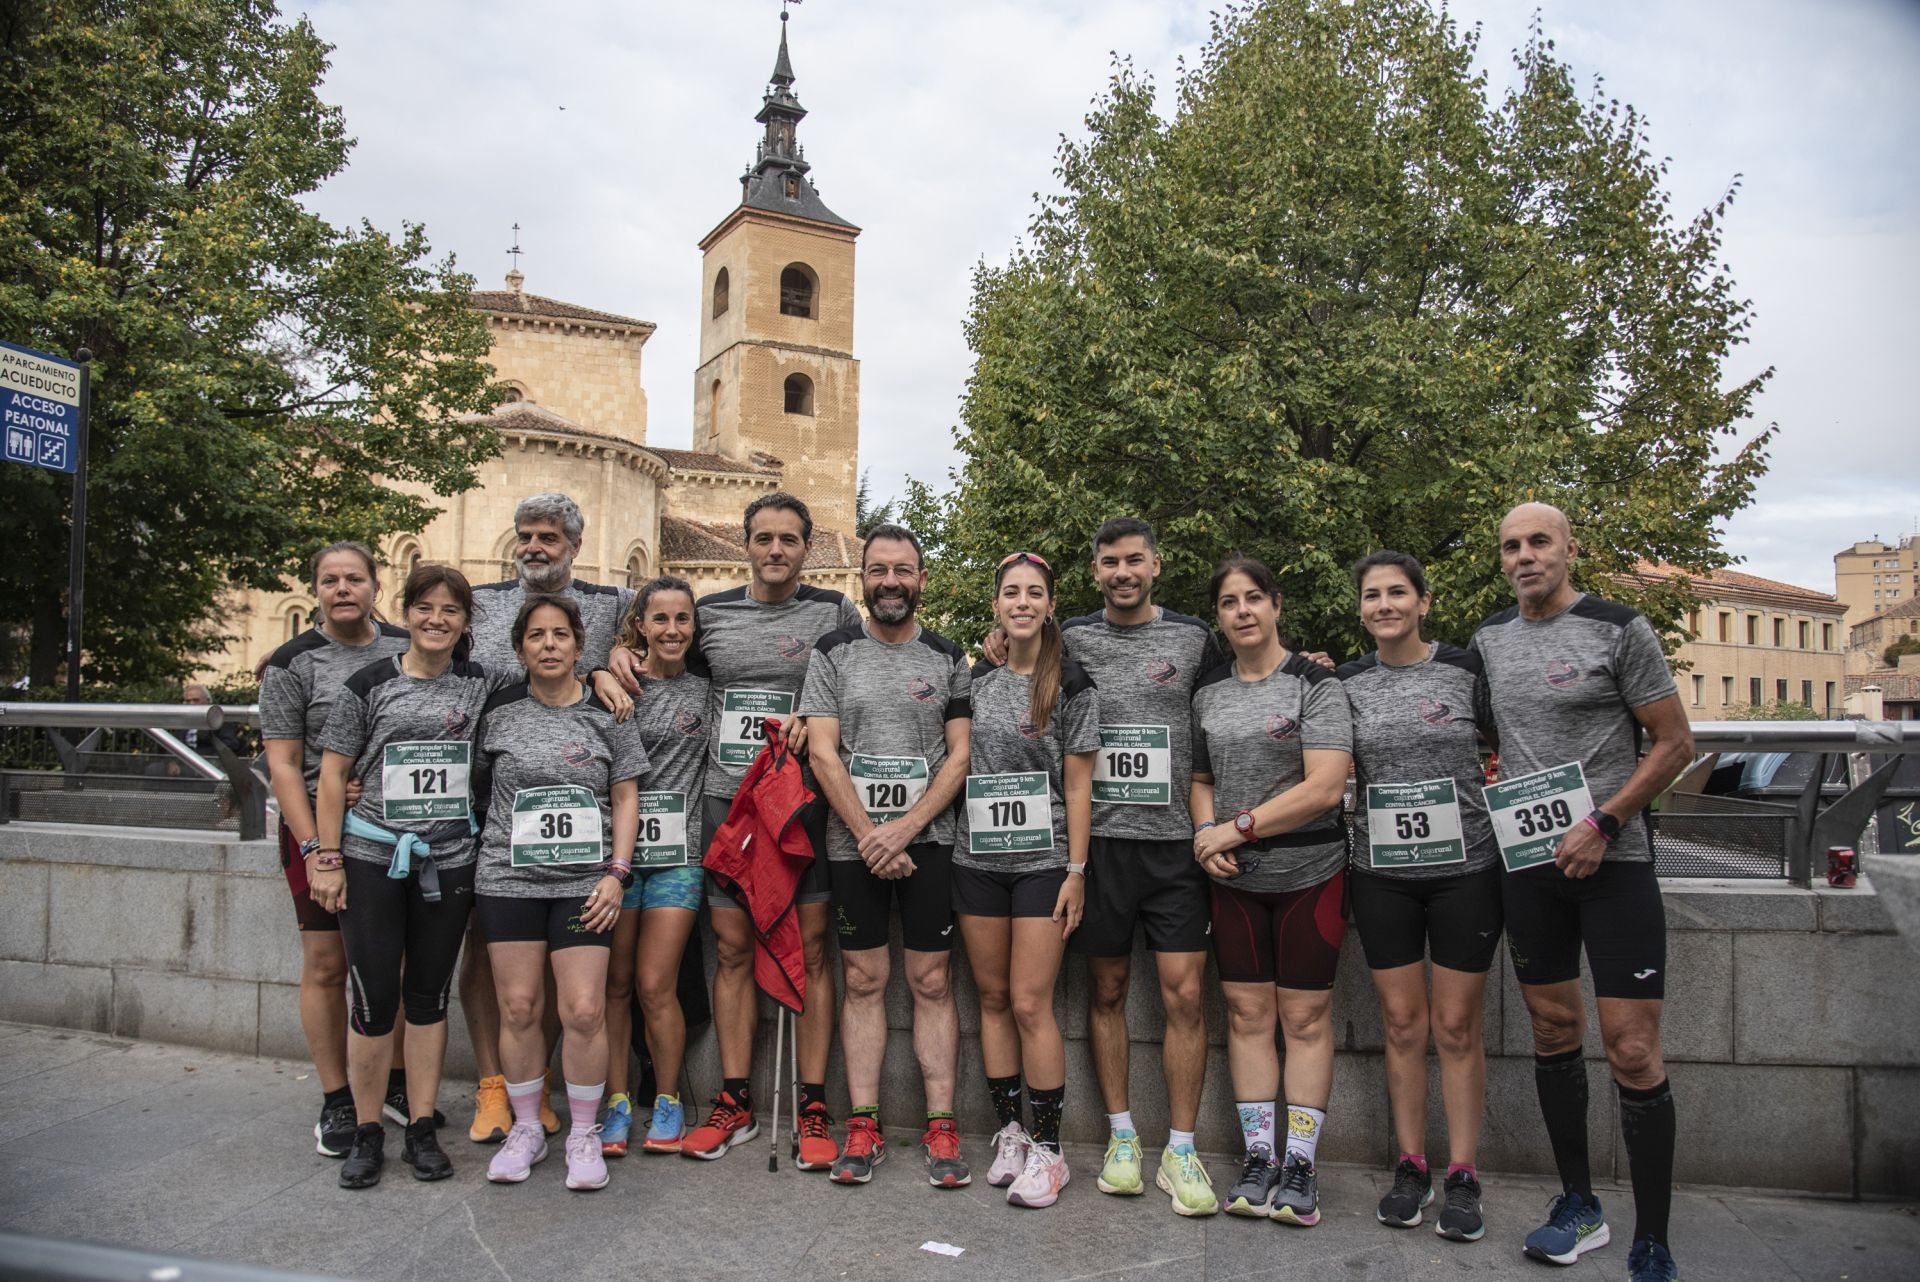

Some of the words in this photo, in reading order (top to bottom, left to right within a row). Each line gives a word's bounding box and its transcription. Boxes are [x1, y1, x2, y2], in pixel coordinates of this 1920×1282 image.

[2, 353, 76, 382] APARCAMIENTO
[0, 368, 76, 398] ACUEDUCTO
[11, 393, 66, 417] ACCESO
[5, 409, 70, 436] PEATONAL
[1107, 752, 1148, 778] 169
[409, 769, 447, 794] 121
[866, 783, 907, 808] 120
[541, 813, 572, 838] 36
[989, 801, 1026, 826] 170
[1395, 812, 1430, 840] 53
[1515, 799, 1572, 837] 339
